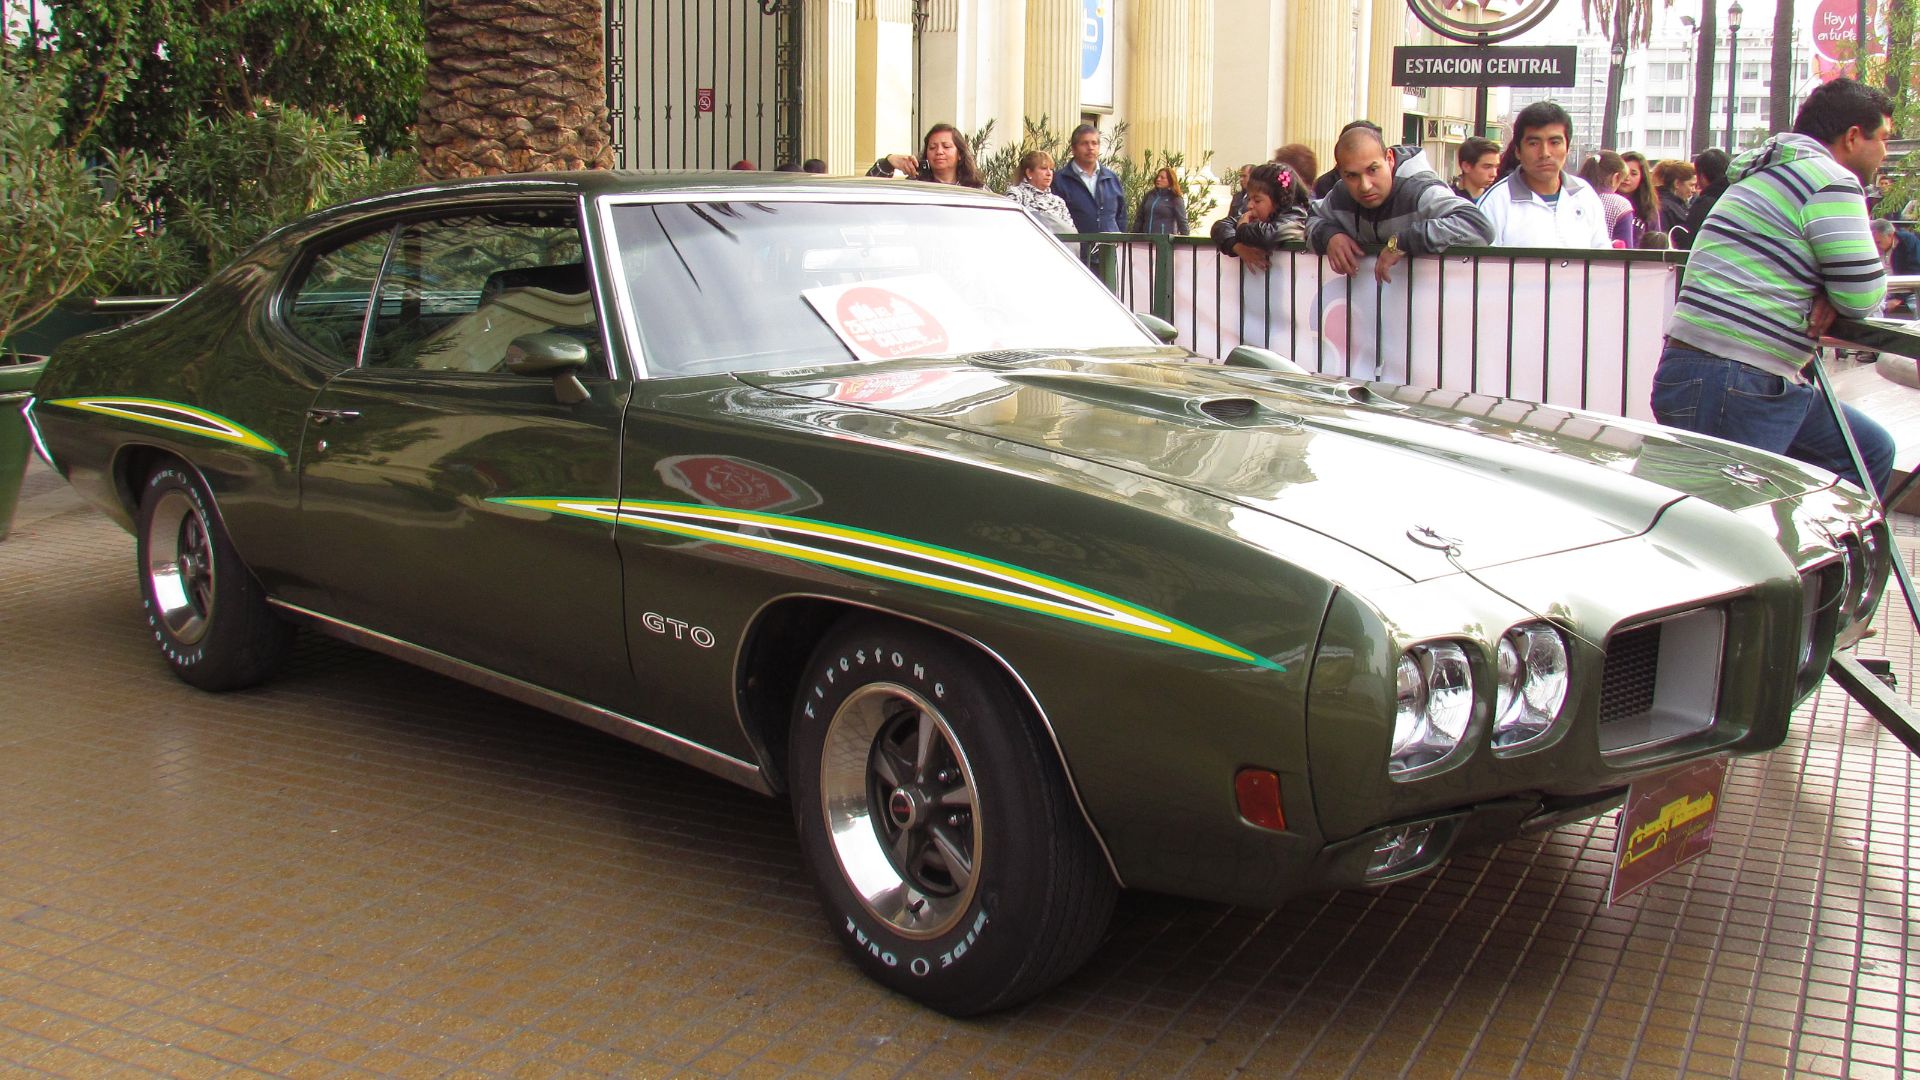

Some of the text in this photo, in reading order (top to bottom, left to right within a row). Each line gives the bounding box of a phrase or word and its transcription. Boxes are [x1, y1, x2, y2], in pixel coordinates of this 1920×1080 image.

[1823, 12, 1872, 30] Hay via
[1842, 29, 1873, 42] Plaa
[1405, 58, 1561, 74] ESTACION CENTRAL
[642, 611, 716, 648] GTO
[845, 914, 898, 968] OVAL
[939, 908, 990, 969] WIDE
